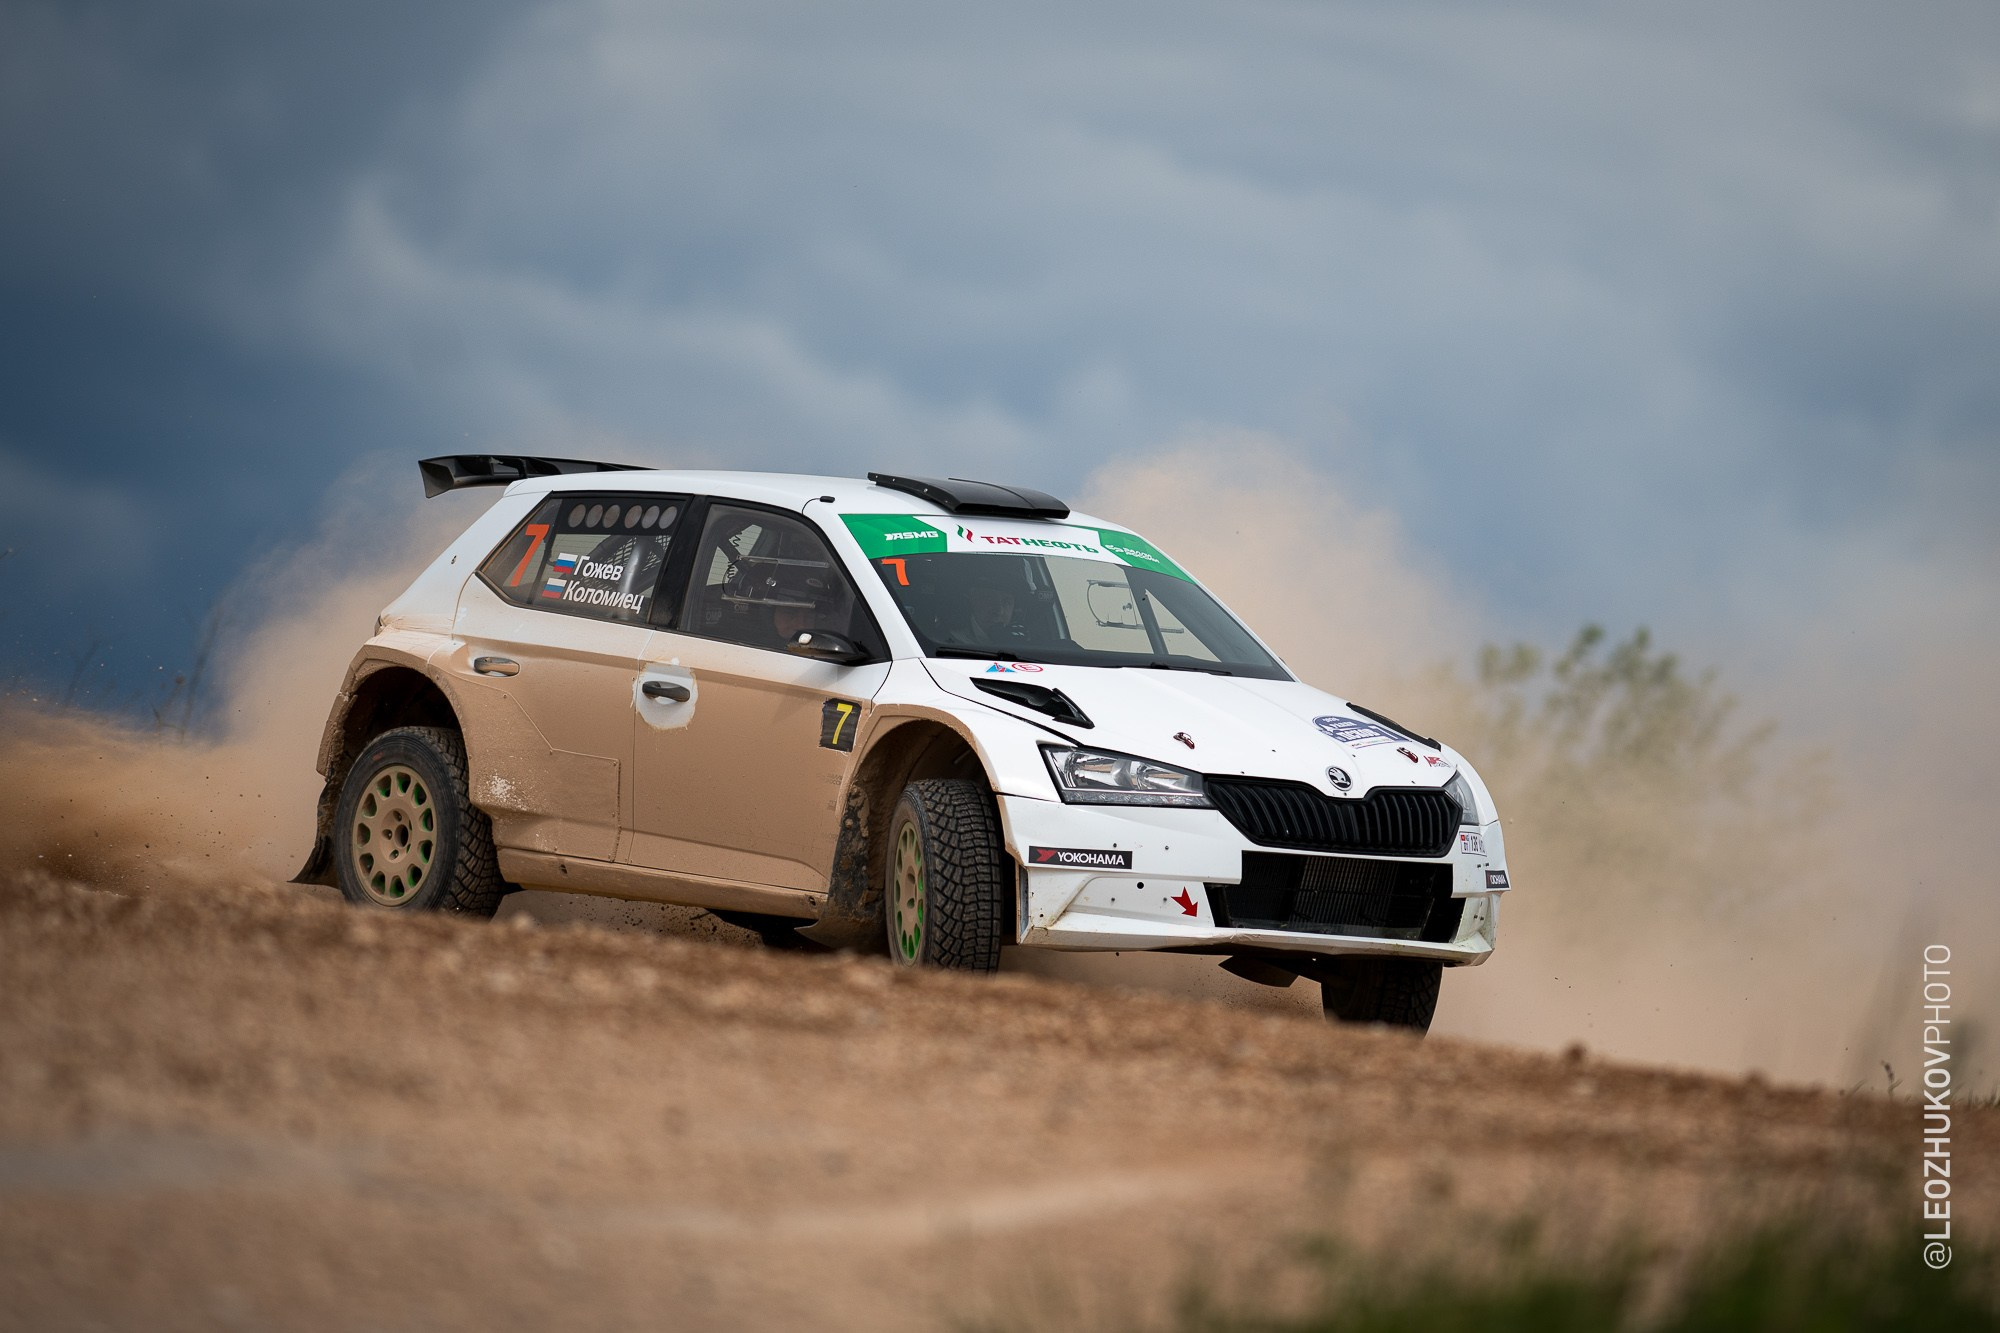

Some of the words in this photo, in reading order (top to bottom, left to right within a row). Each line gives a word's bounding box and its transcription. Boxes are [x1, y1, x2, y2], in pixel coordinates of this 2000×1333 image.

[510, 524, 550, 587] 7
[980, 536, 1099, 554] ТАТНЕФТЬ
[573, 555, 624, 581] Гожев
[881, 558, 910, 586] 7
[563, 580, 645, 614] Коломиец
[831, 703, 854, 745] 7
[1057, 851, 1125, 866] YOKOHAMA
